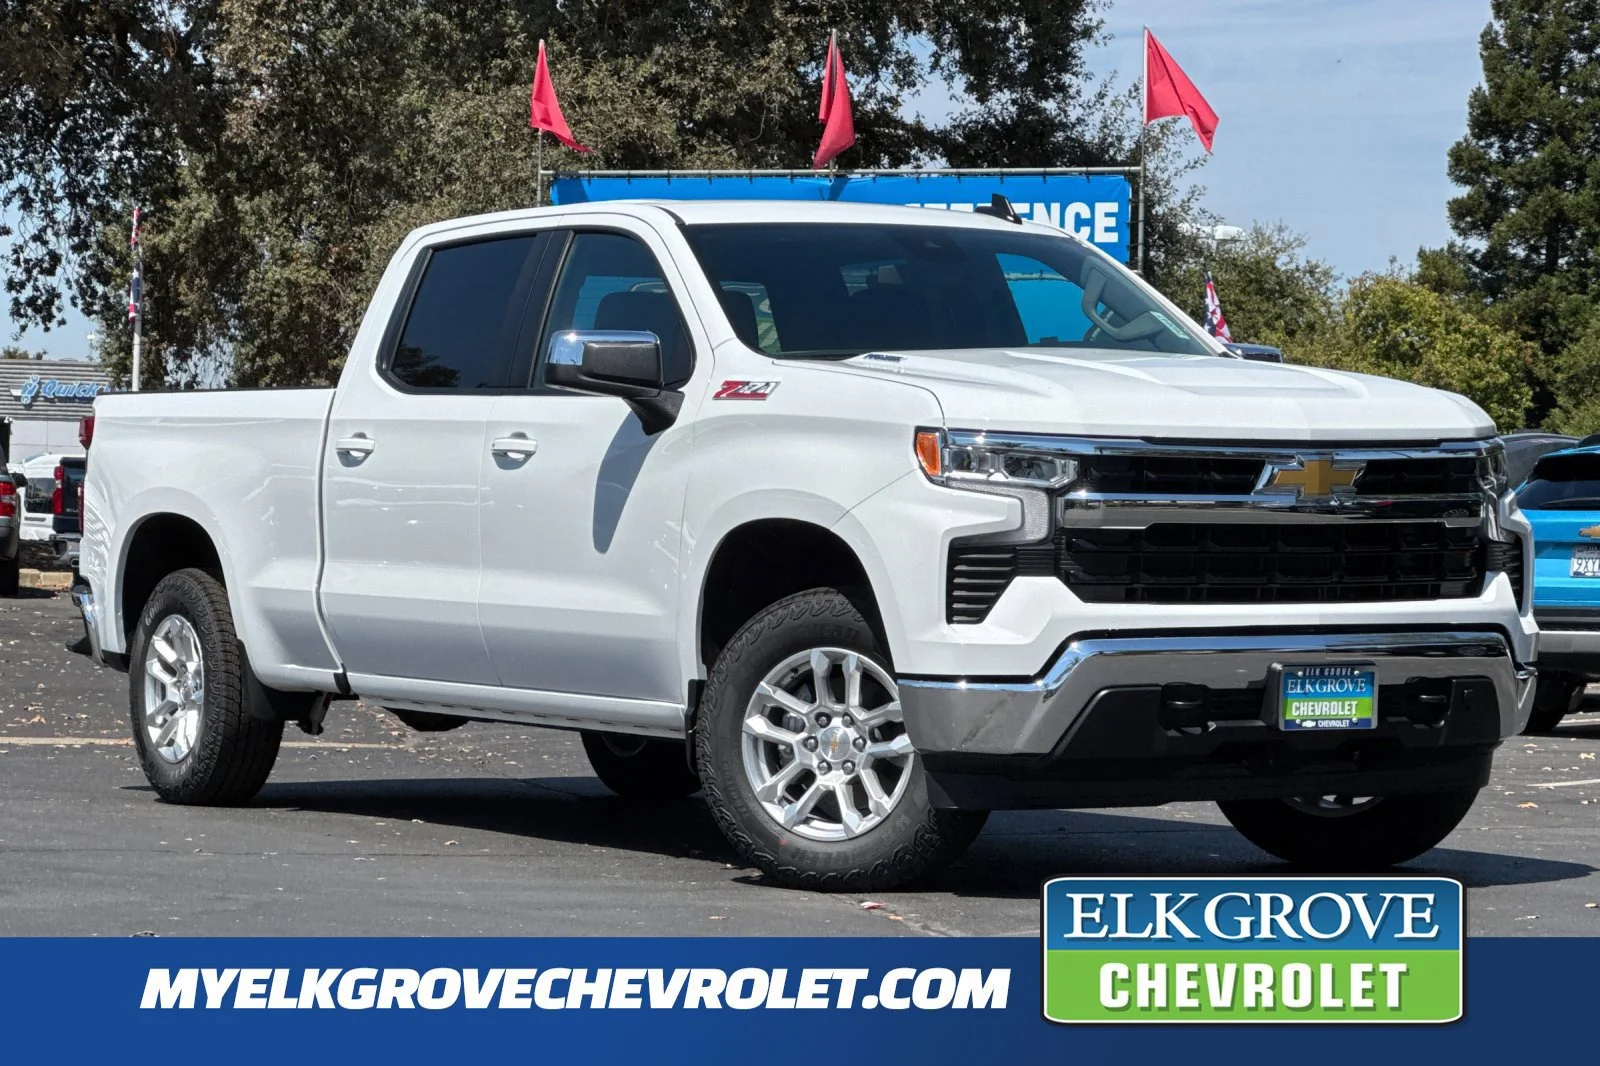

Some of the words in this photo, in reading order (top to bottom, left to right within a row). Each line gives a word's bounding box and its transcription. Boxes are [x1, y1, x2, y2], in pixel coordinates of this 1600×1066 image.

[41, 379, 99, 398] Quick
[1291, 701, 1358, 716] CHEVROLET
[1317, 720, 1350, 728] CHEVROLET
